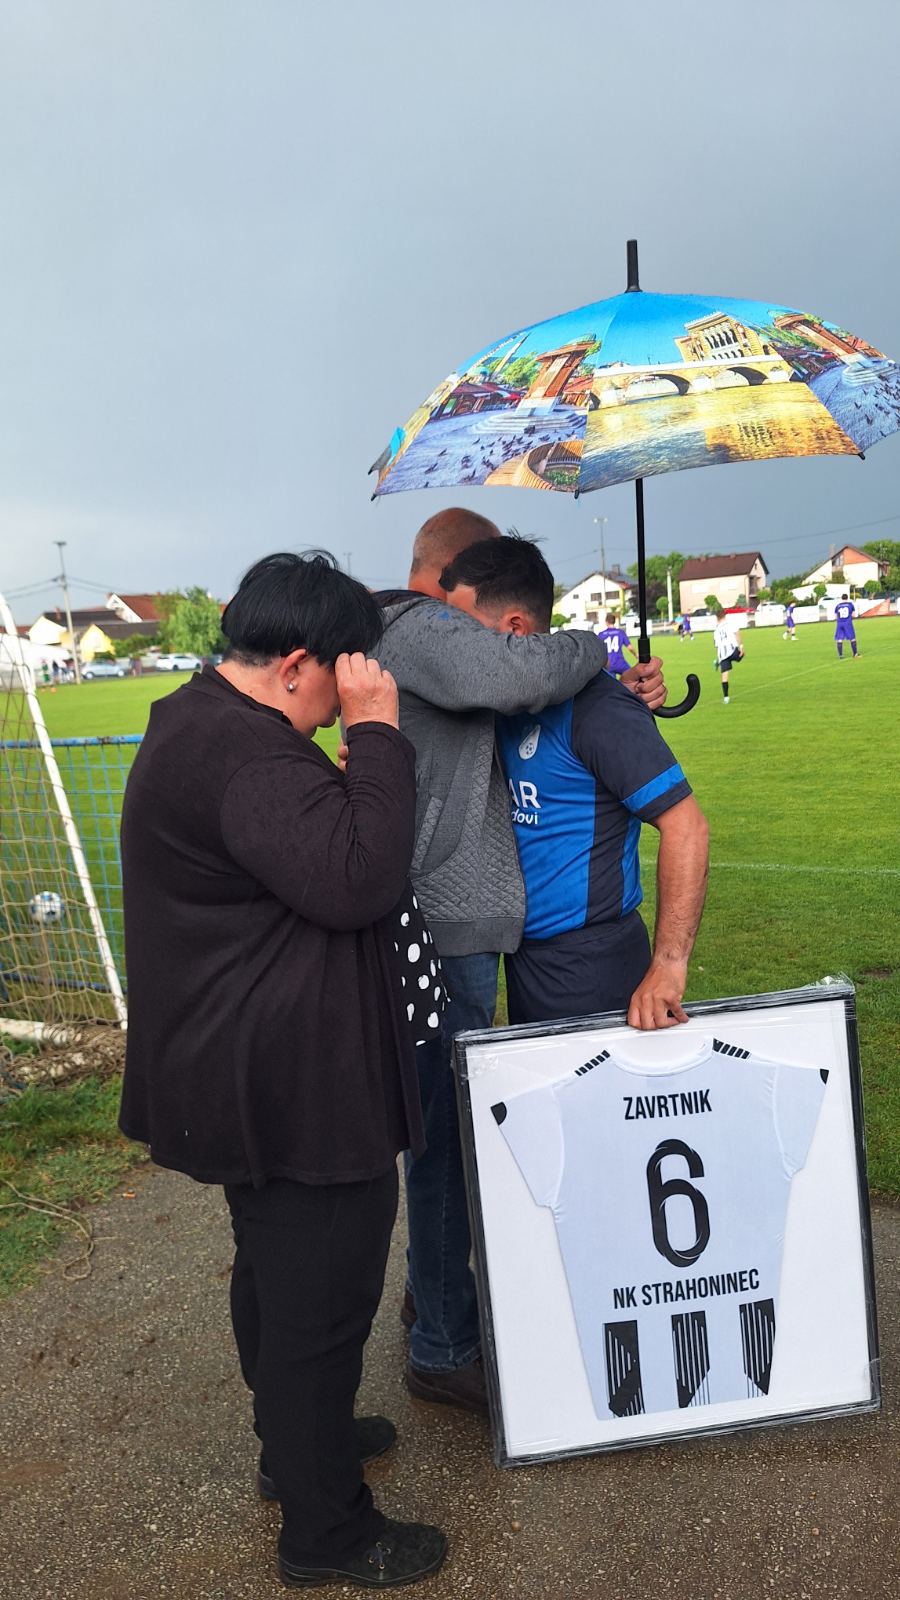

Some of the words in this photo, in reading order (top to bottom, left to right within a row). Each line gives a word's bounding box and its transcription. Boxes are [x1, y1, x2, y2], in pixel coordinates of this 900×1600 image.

[603, 635, 620, 653] 14
[623, 1089, 713, 1121] ZAVRTNIK
[646, 1138, 711, 1268] 6
[613, 1286, 638, 1310] NK
[641, 1268, 760, 1306] STRAHONINEC
